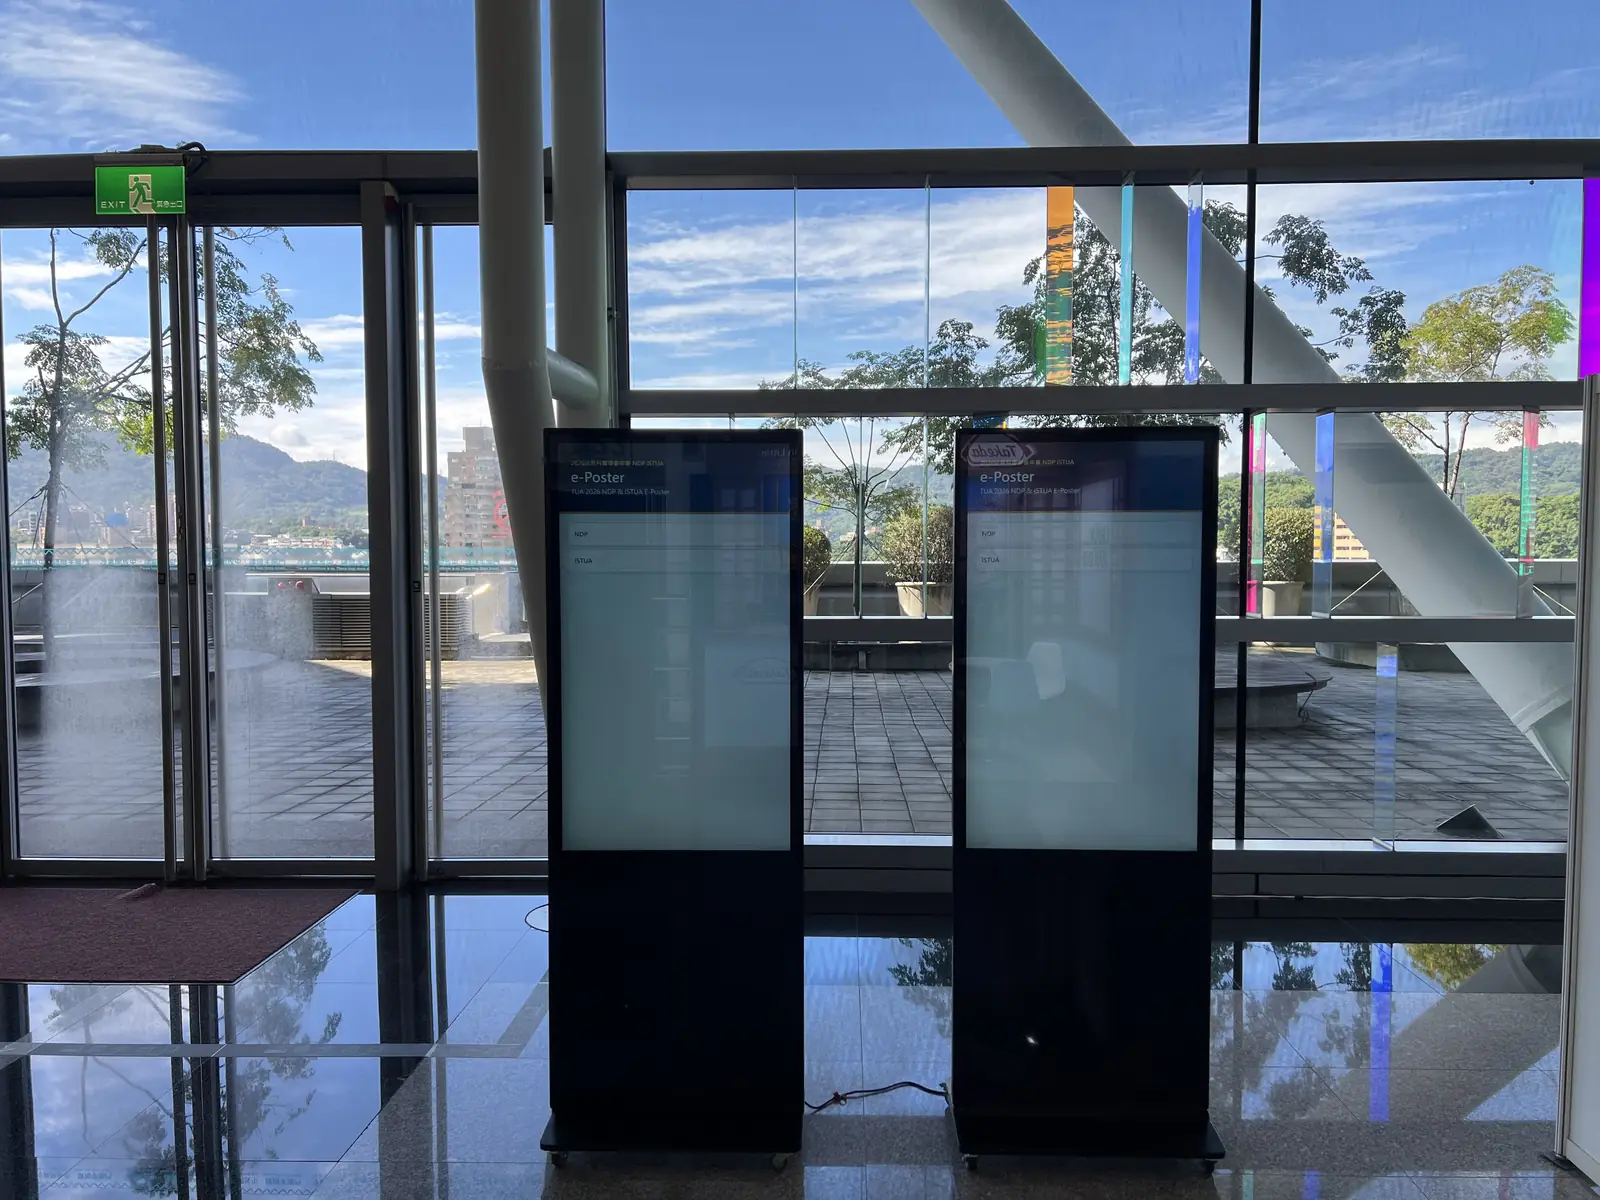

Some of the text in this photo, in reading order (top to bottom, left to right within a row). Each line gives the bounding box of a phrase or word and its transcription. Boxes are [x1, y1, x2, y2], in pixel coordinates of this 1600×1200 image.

[100, 201, 126, 209] EXIT
[570, 471, 625, 483] e-Poster
[980, 471, 1035, 483] e-Poster
